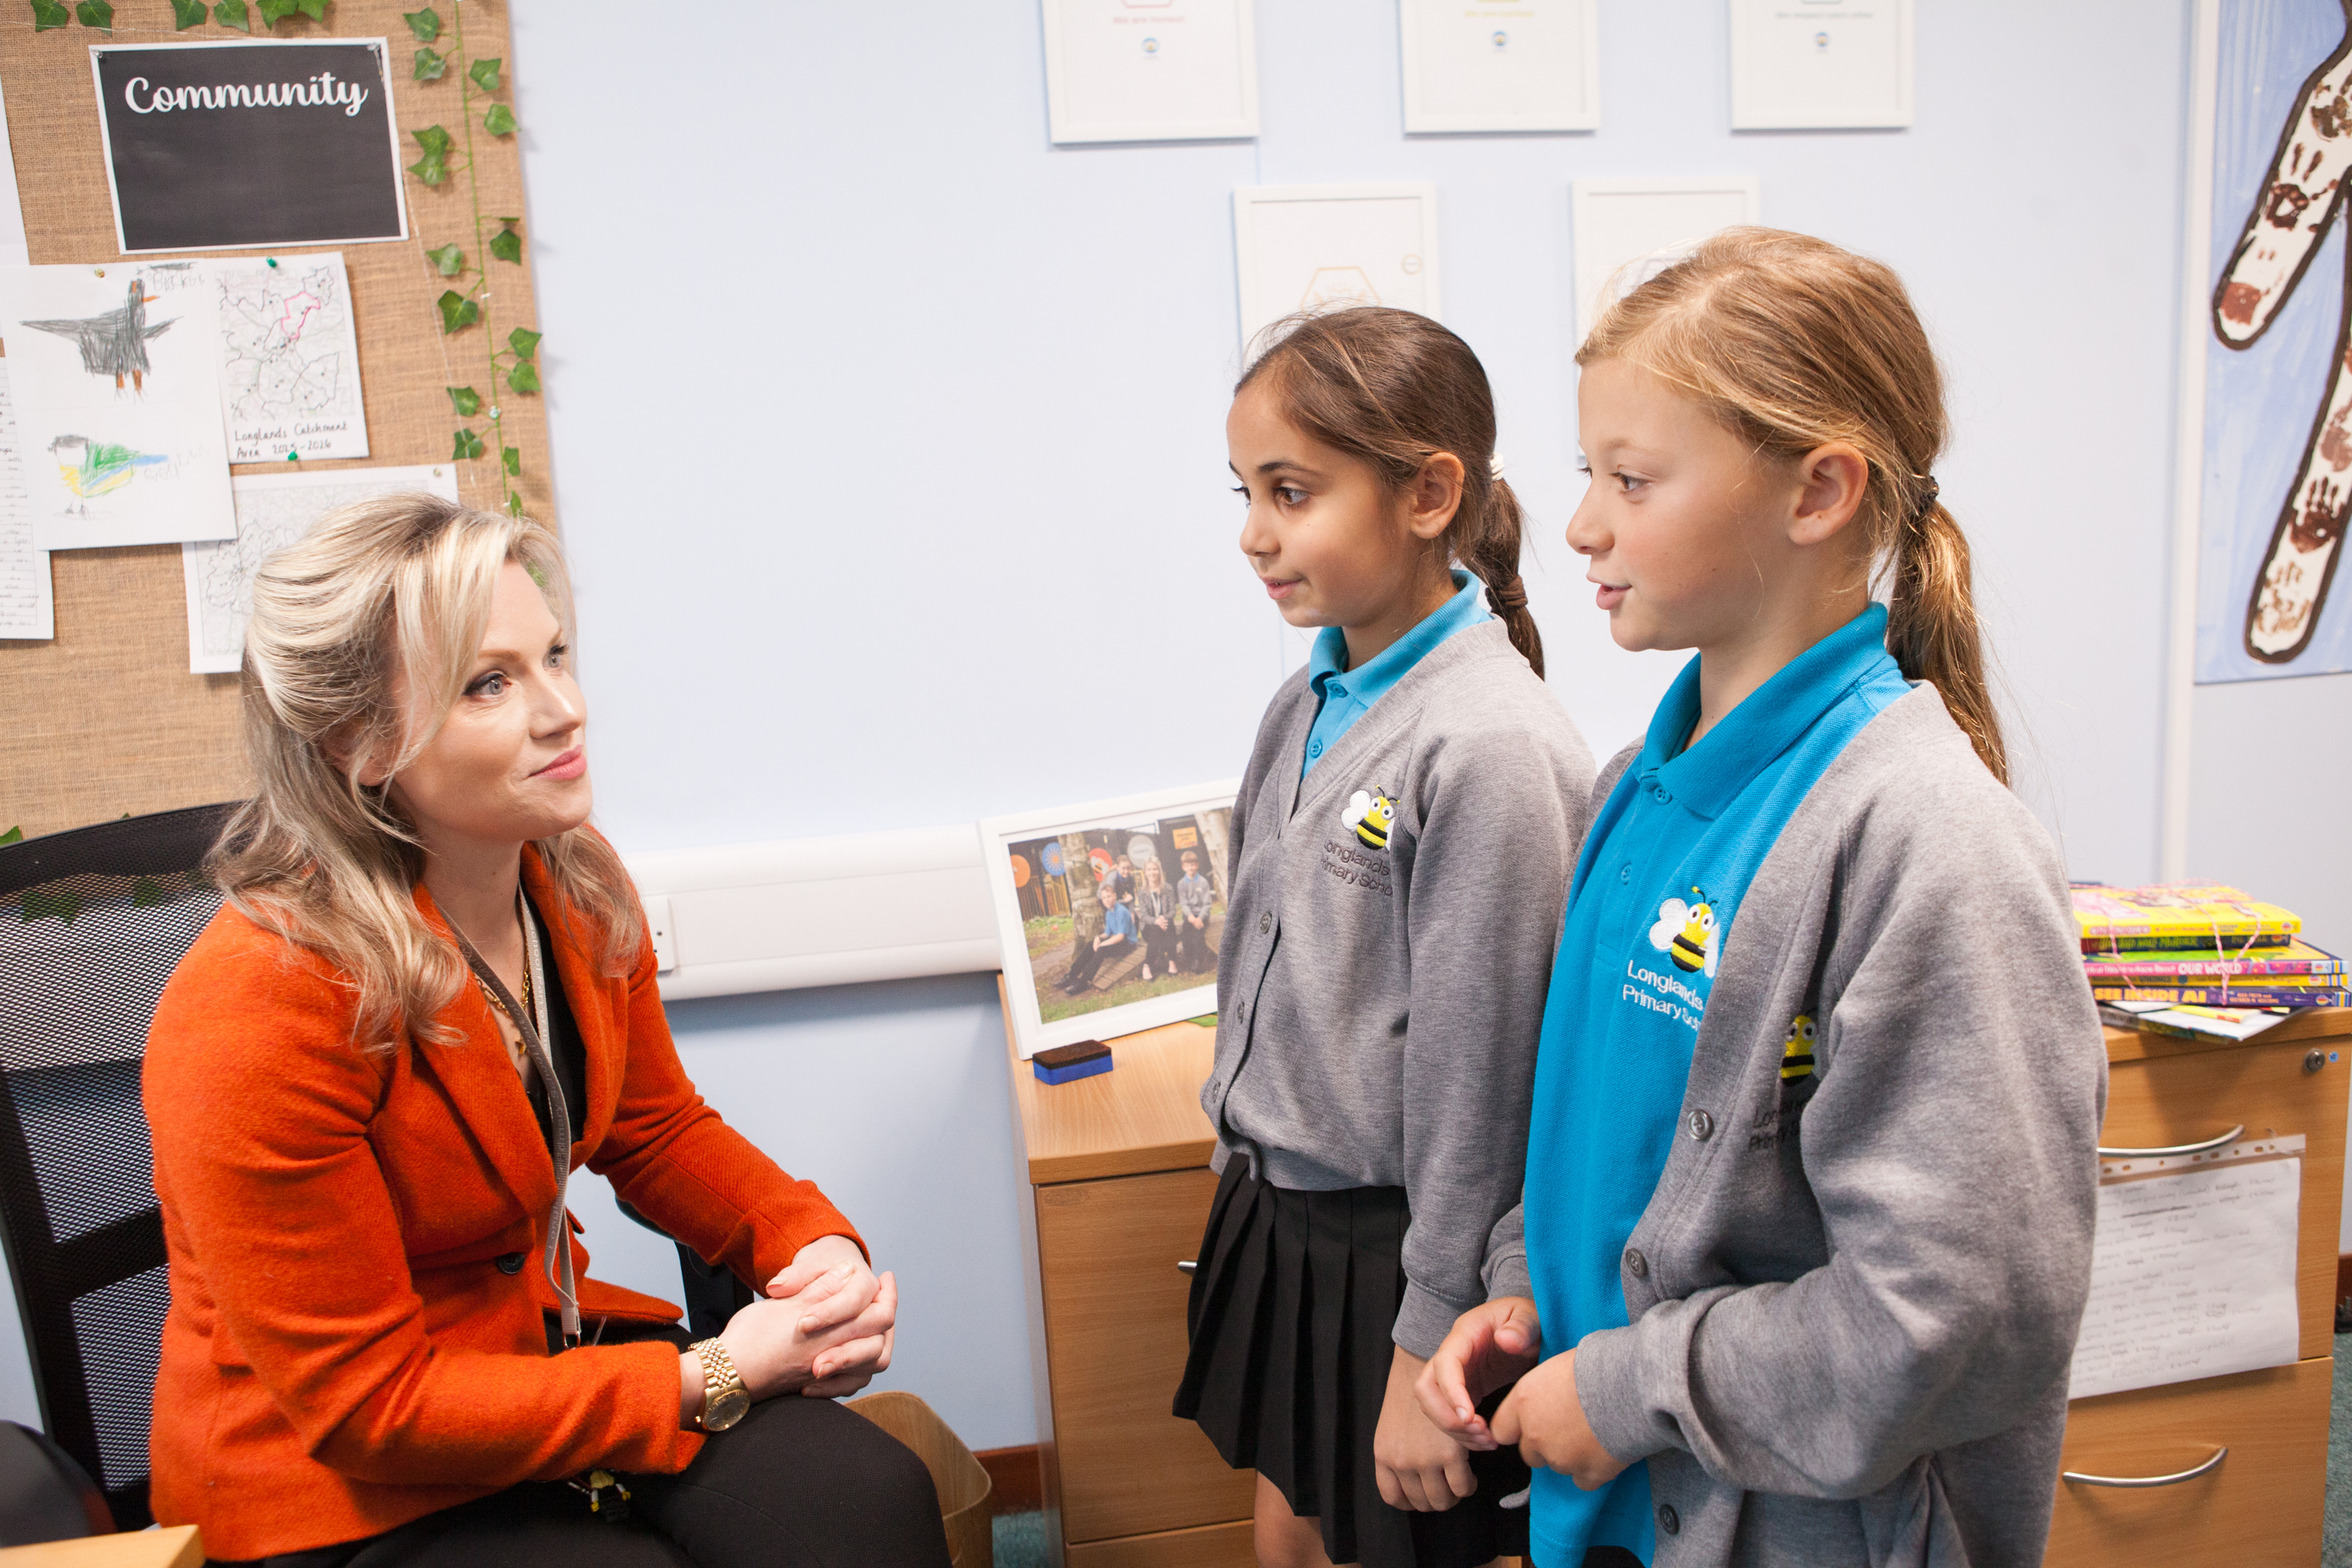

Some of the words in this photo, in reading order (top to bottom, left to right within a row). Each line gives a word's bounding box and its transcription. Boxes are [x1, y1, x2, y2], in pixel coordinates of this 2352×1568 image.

[125, 72, 369, 117] Community
[235, 427, 287, 447] Longlands
[294, 421, 348, 436] Catchment
[236, 446, 260, 459] Area
[1324, 839, 1391, 876] onglands
[1359, 874, 1393, 896] Scho
[528, 921, 543, 972] School
[2177, 962, 2204, 974] OUR
[1628, 960, 1703, 1011] Longlands
[2093, 987, 2123, 1001] SEE
[2124, 988, 2179, 1002] INSIDE
[2181, 990, 2207, 1003] AI
[1623, 984, 1681, 1019] Primary
